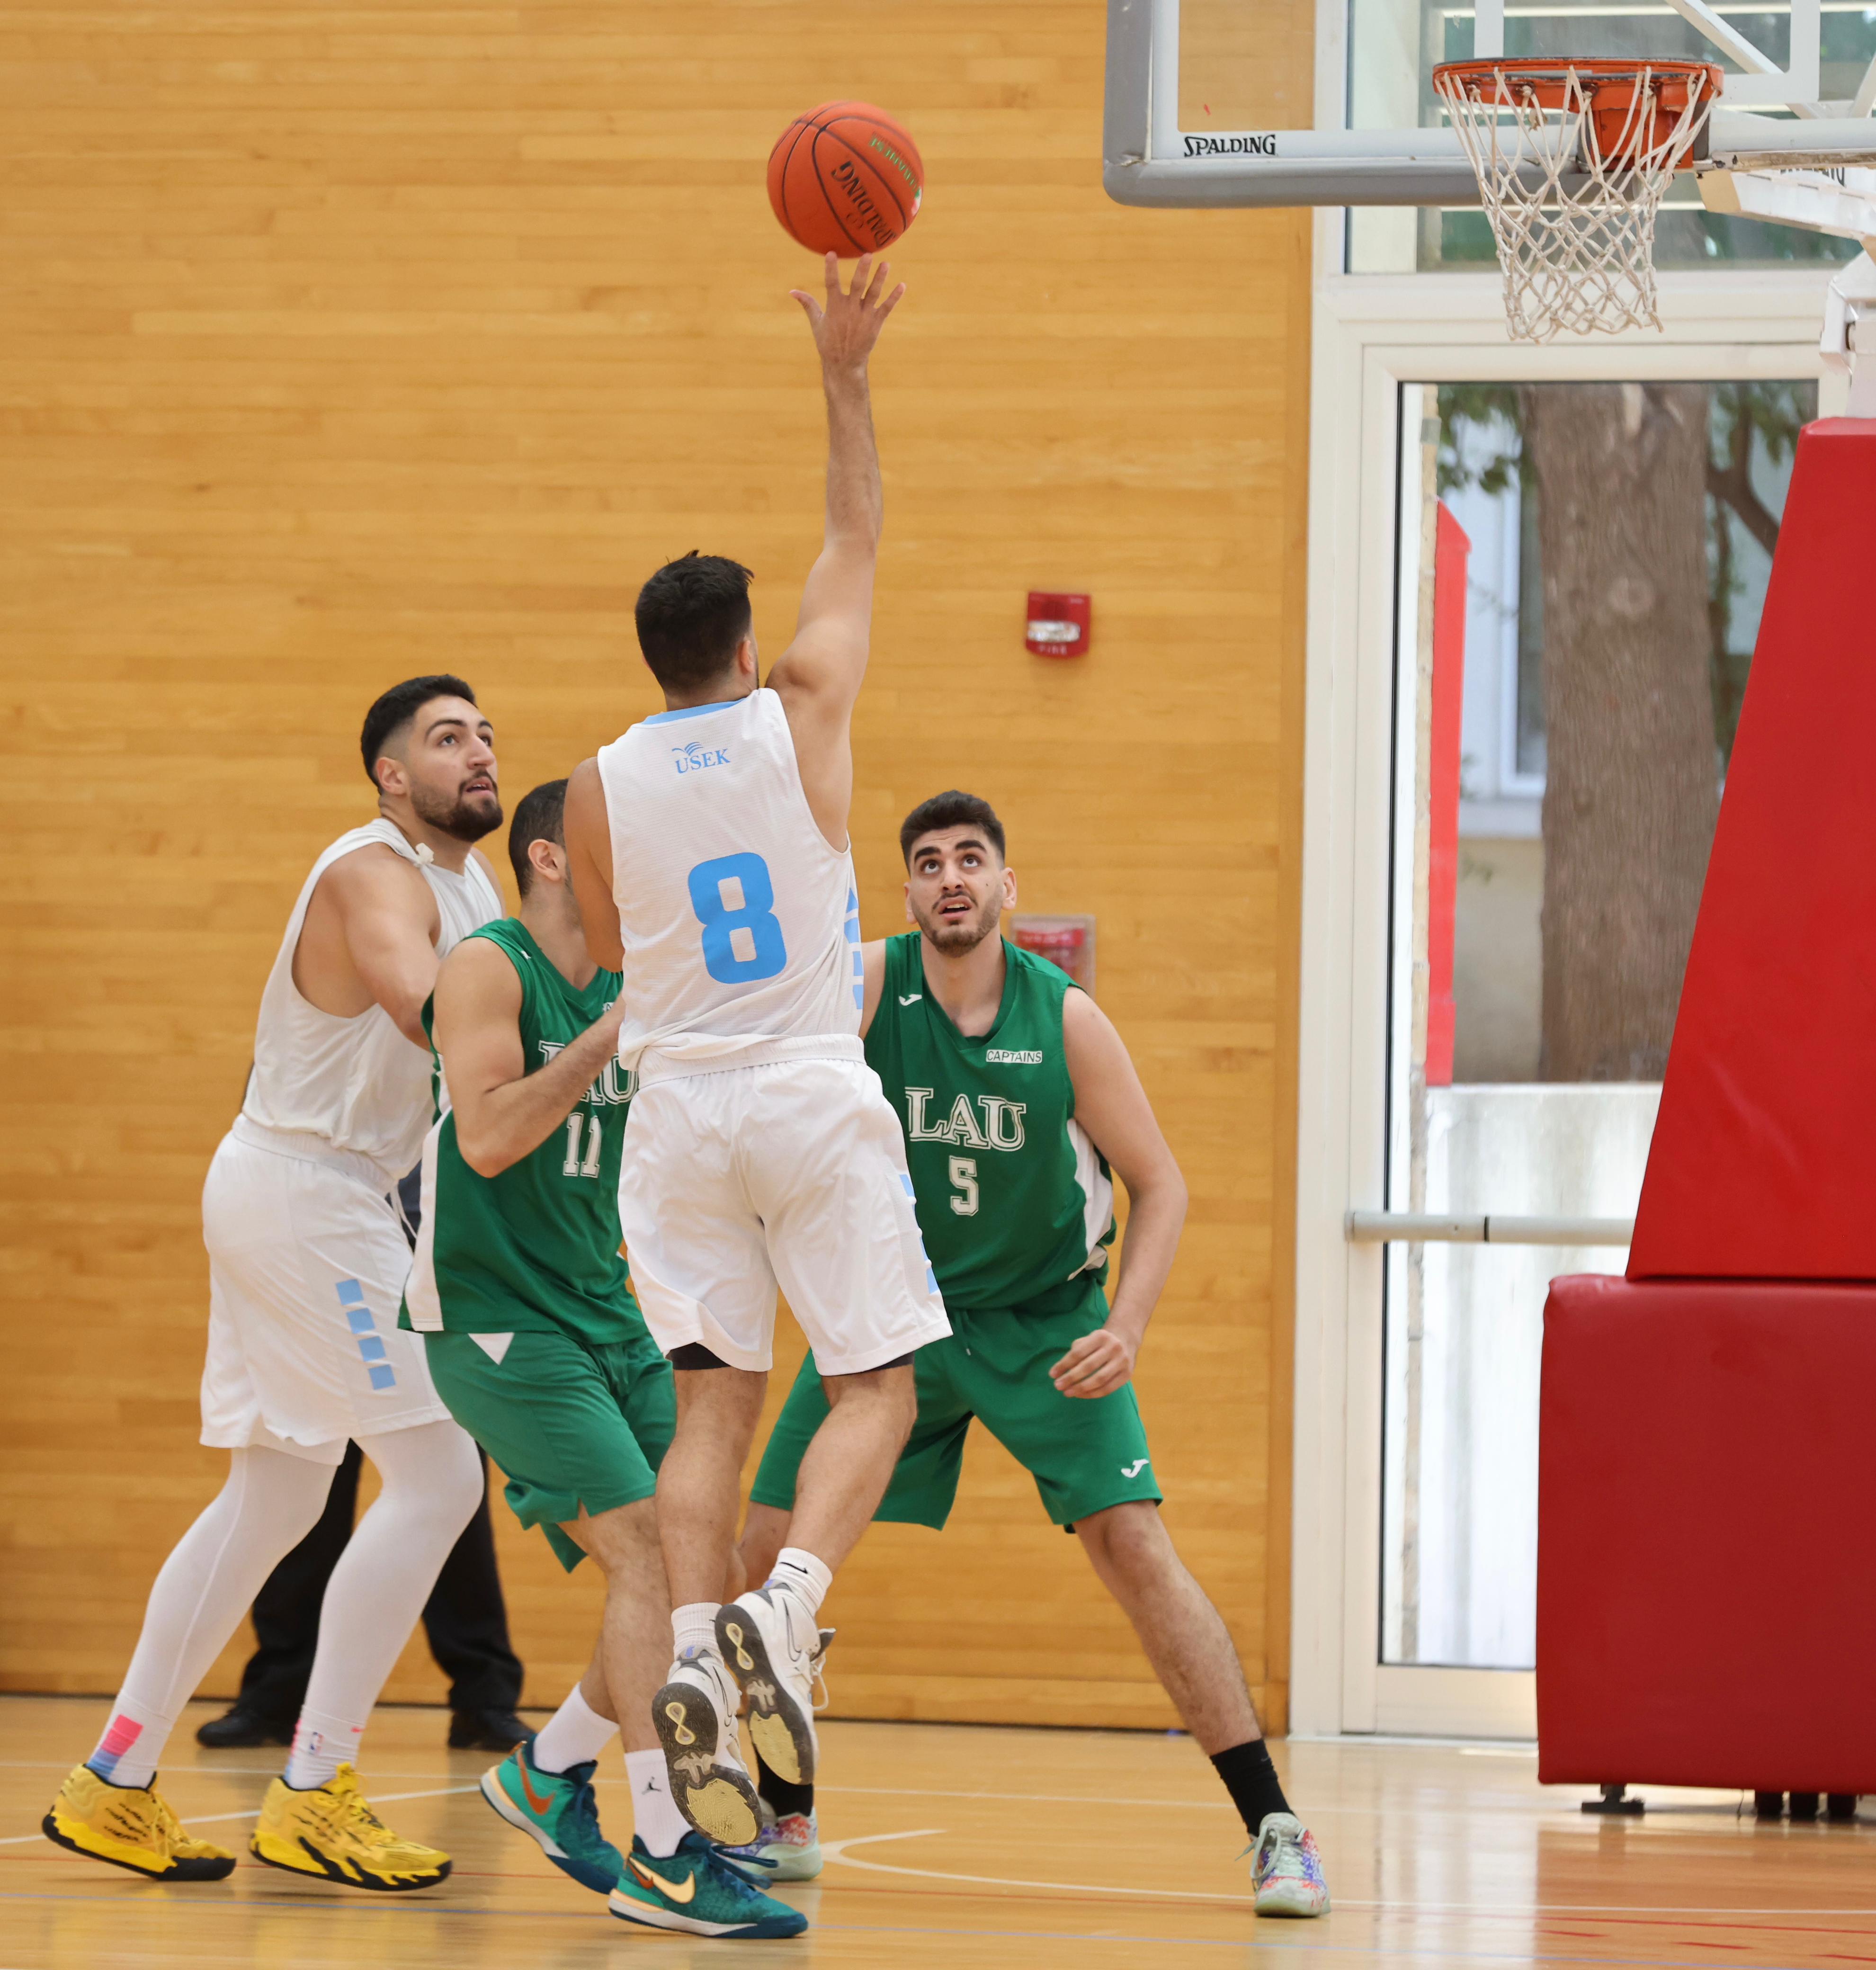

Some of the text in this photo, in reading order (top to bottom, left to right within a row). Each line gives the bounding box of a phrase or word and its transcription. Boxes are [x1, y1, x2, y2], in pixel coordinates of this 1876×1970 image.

[1184, 134, 1276, 157] SPALDING
[675, 748, 731, 774] USEK
[688, 852, 787, 984] 8
[987, 1051, 1041, 1063] CAPTAINS
[563, 1112, 600, 1178] 11
[905, 1086, 1027, 1152] LAU
[949, 1155, 979, 1217] 5
